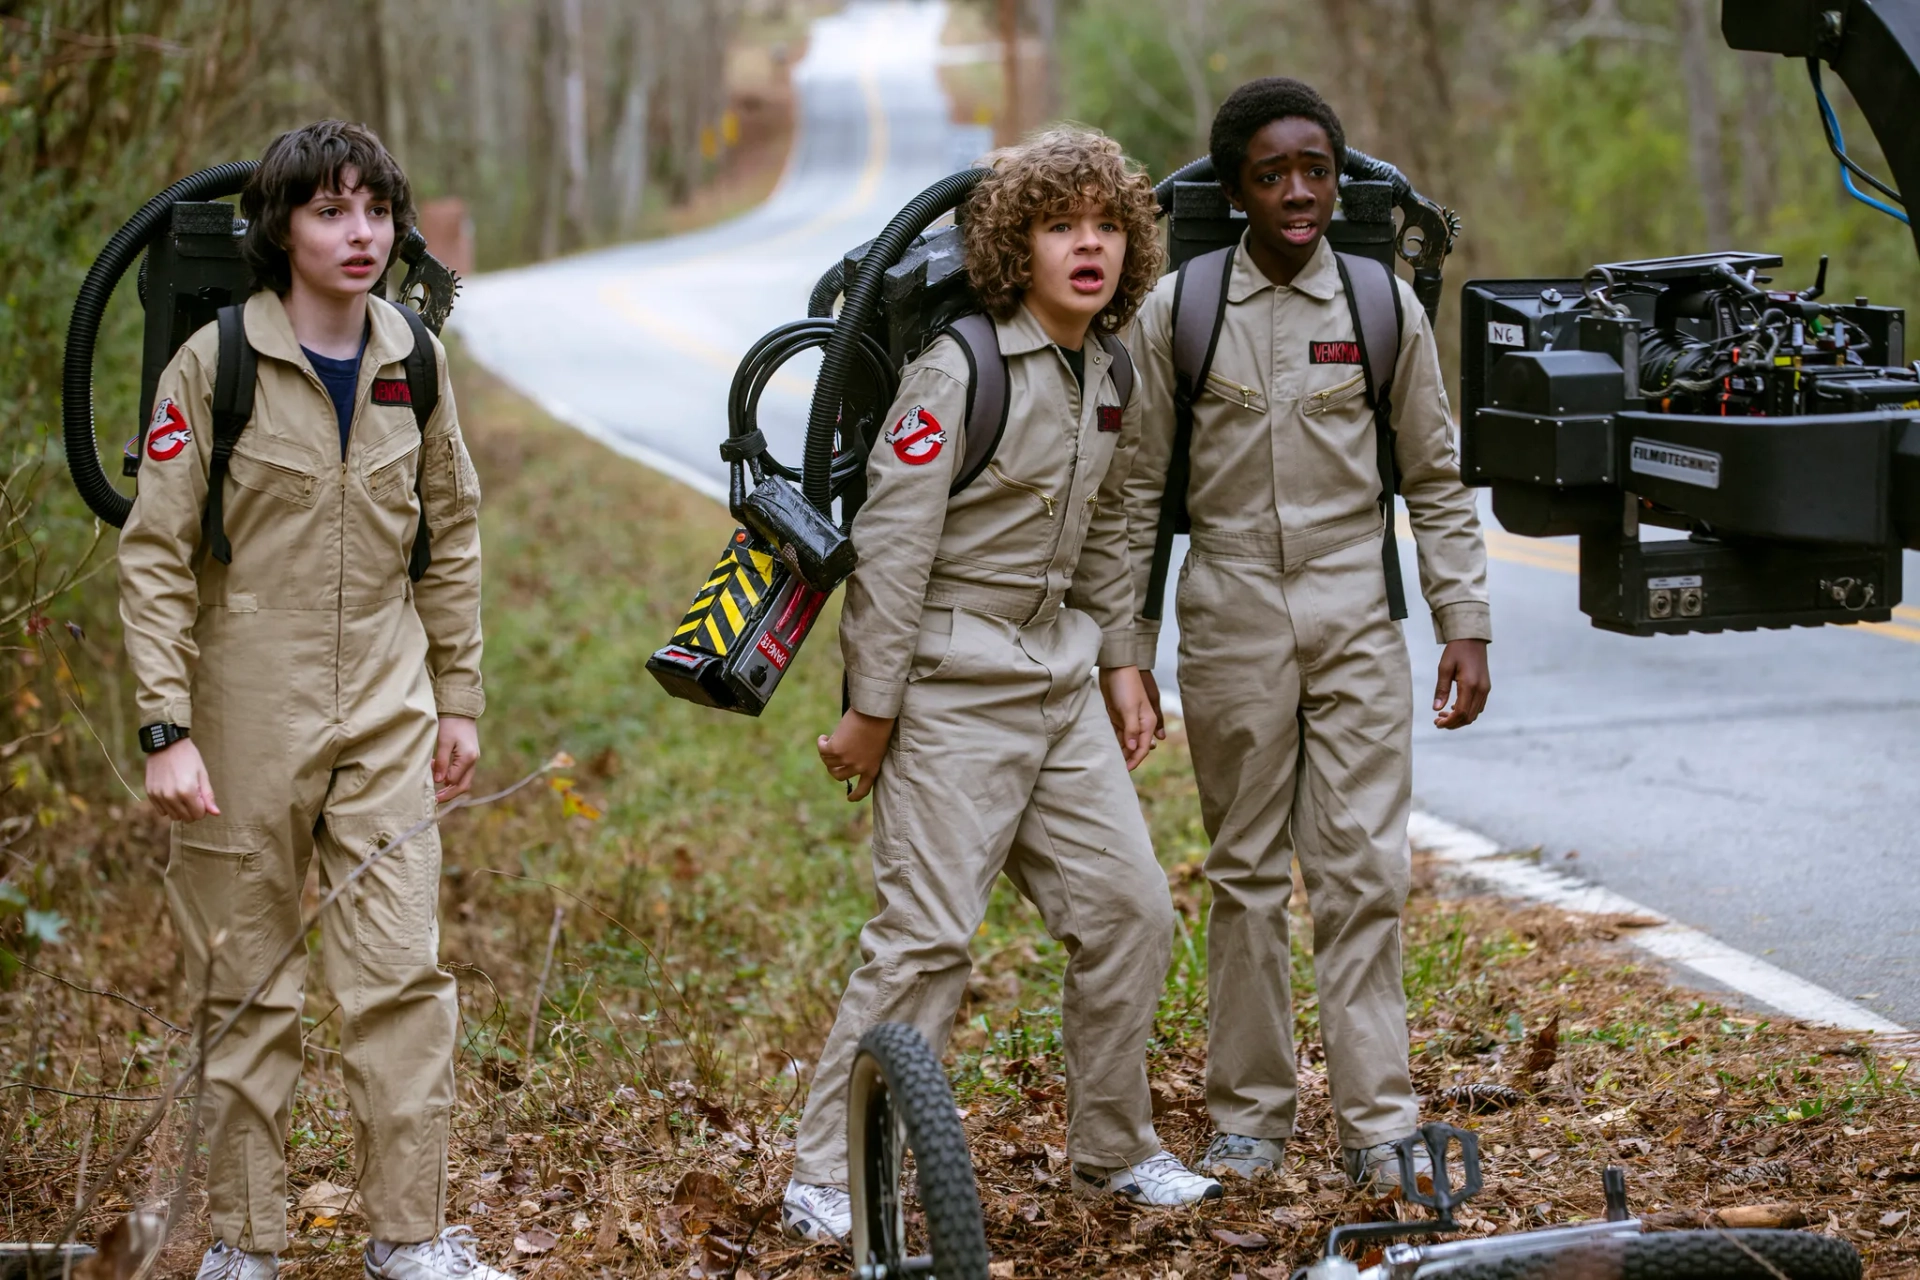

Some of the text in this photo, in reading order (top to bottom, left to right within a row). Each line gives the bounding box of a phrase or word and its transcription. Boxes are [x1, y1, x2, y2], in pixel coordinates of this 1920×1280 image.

[1494, 326, 1513, 343] N6
[1633, 446, 1717, 473] FILMOTECHNIC
[760, 633, 788, 668] DANGER
